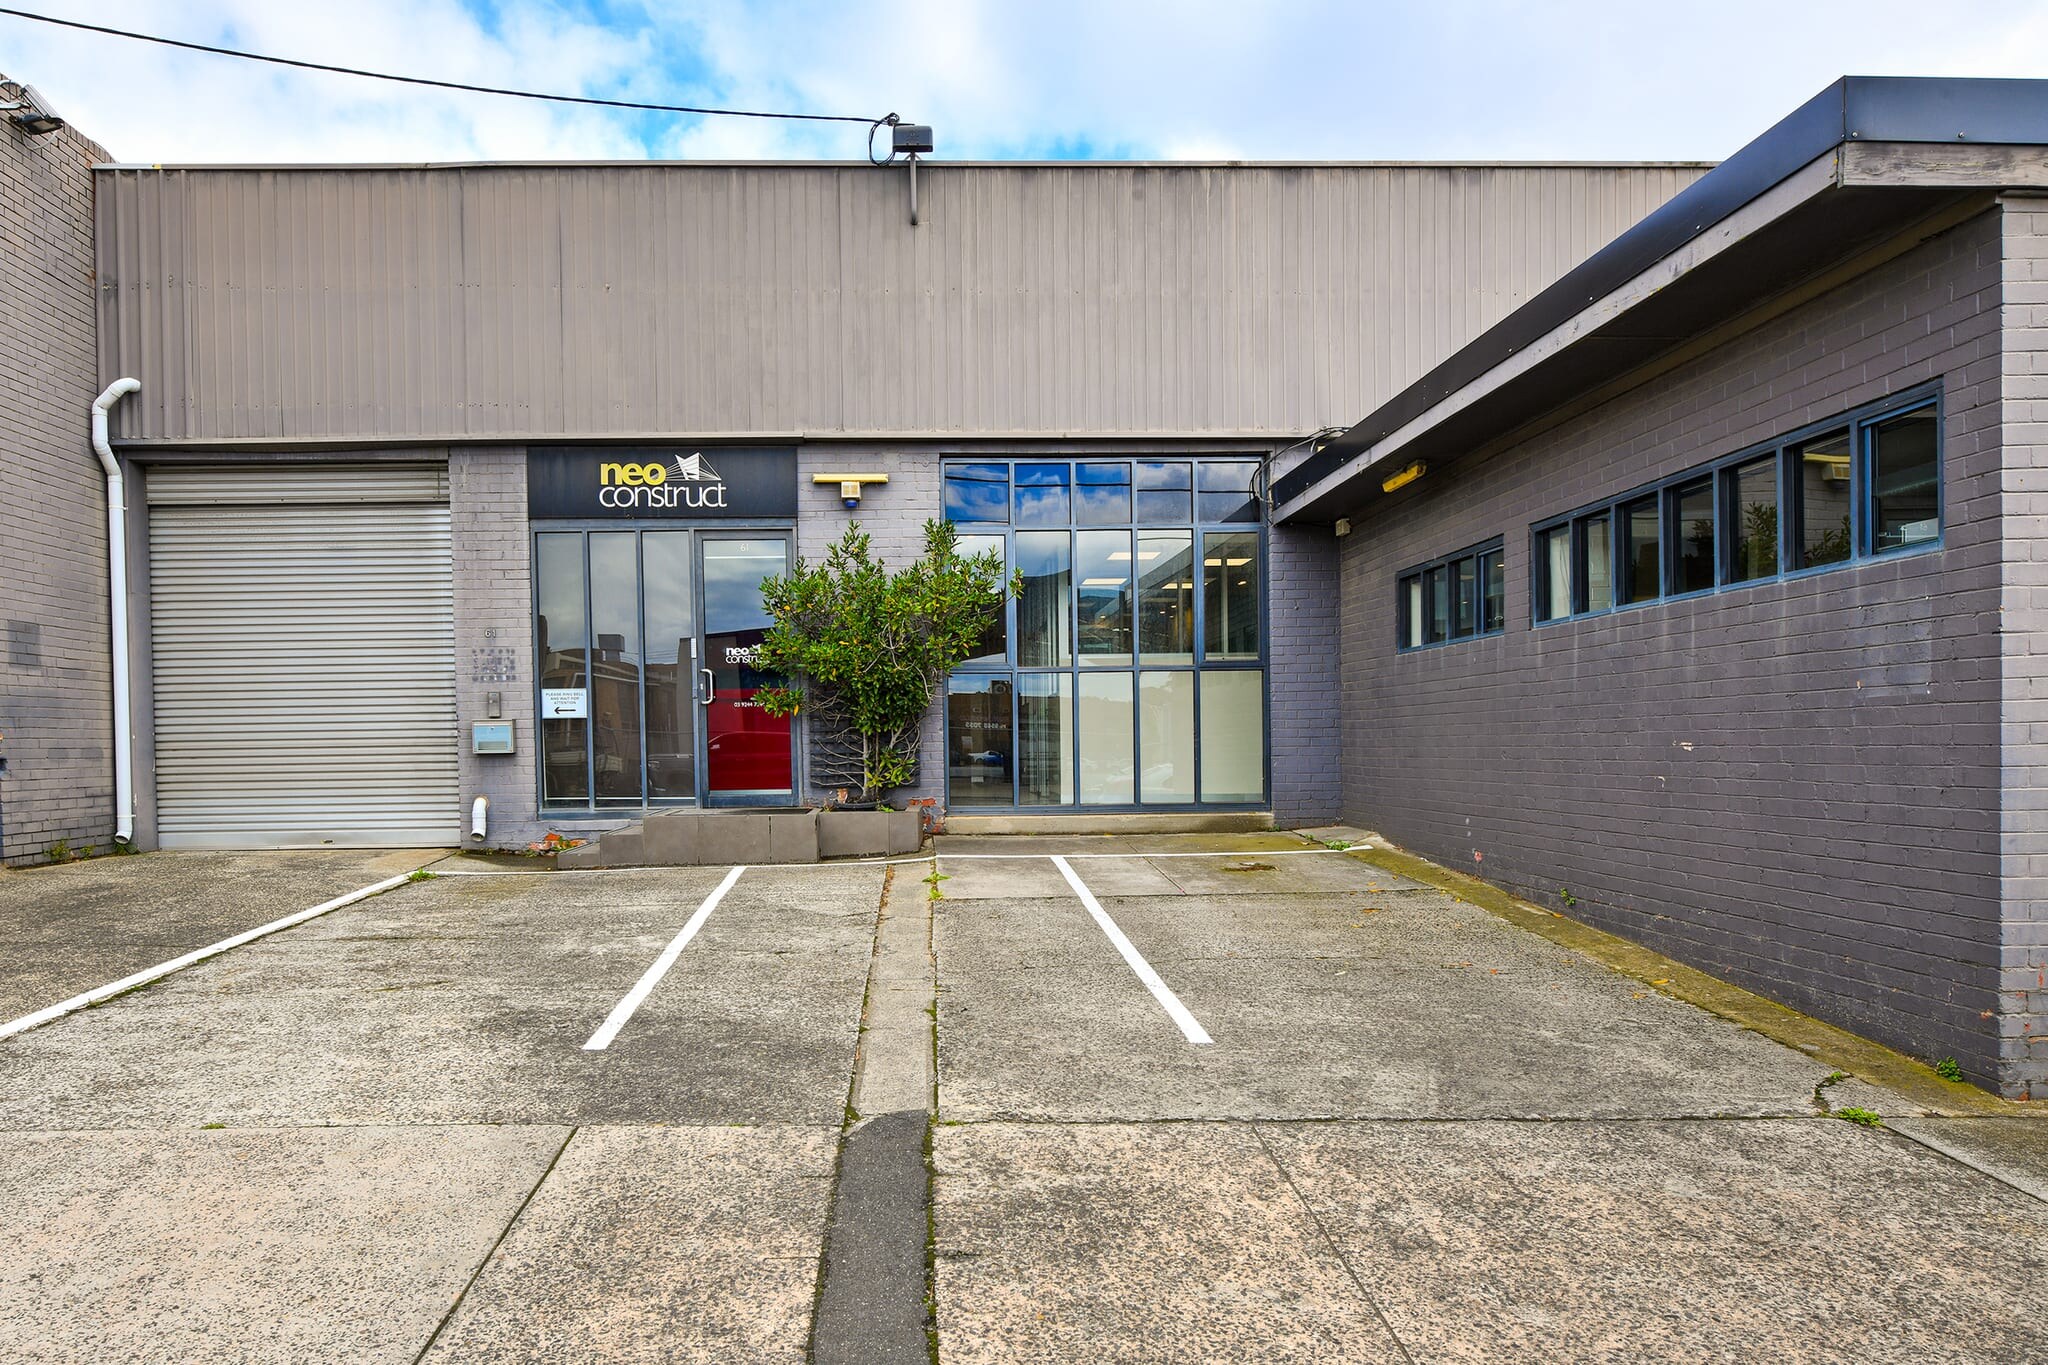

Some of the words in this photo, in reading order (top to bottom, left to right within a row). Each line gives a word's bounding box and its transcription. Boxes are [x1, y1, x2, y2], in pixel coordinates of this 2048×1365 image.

[600, 462, 667, 486] neo
[599, 482, 727, 508] construct
[740, 543, 749, 552] 61
[484, 628, 497, 638] 61
[726, 647, 749, 655] neo
